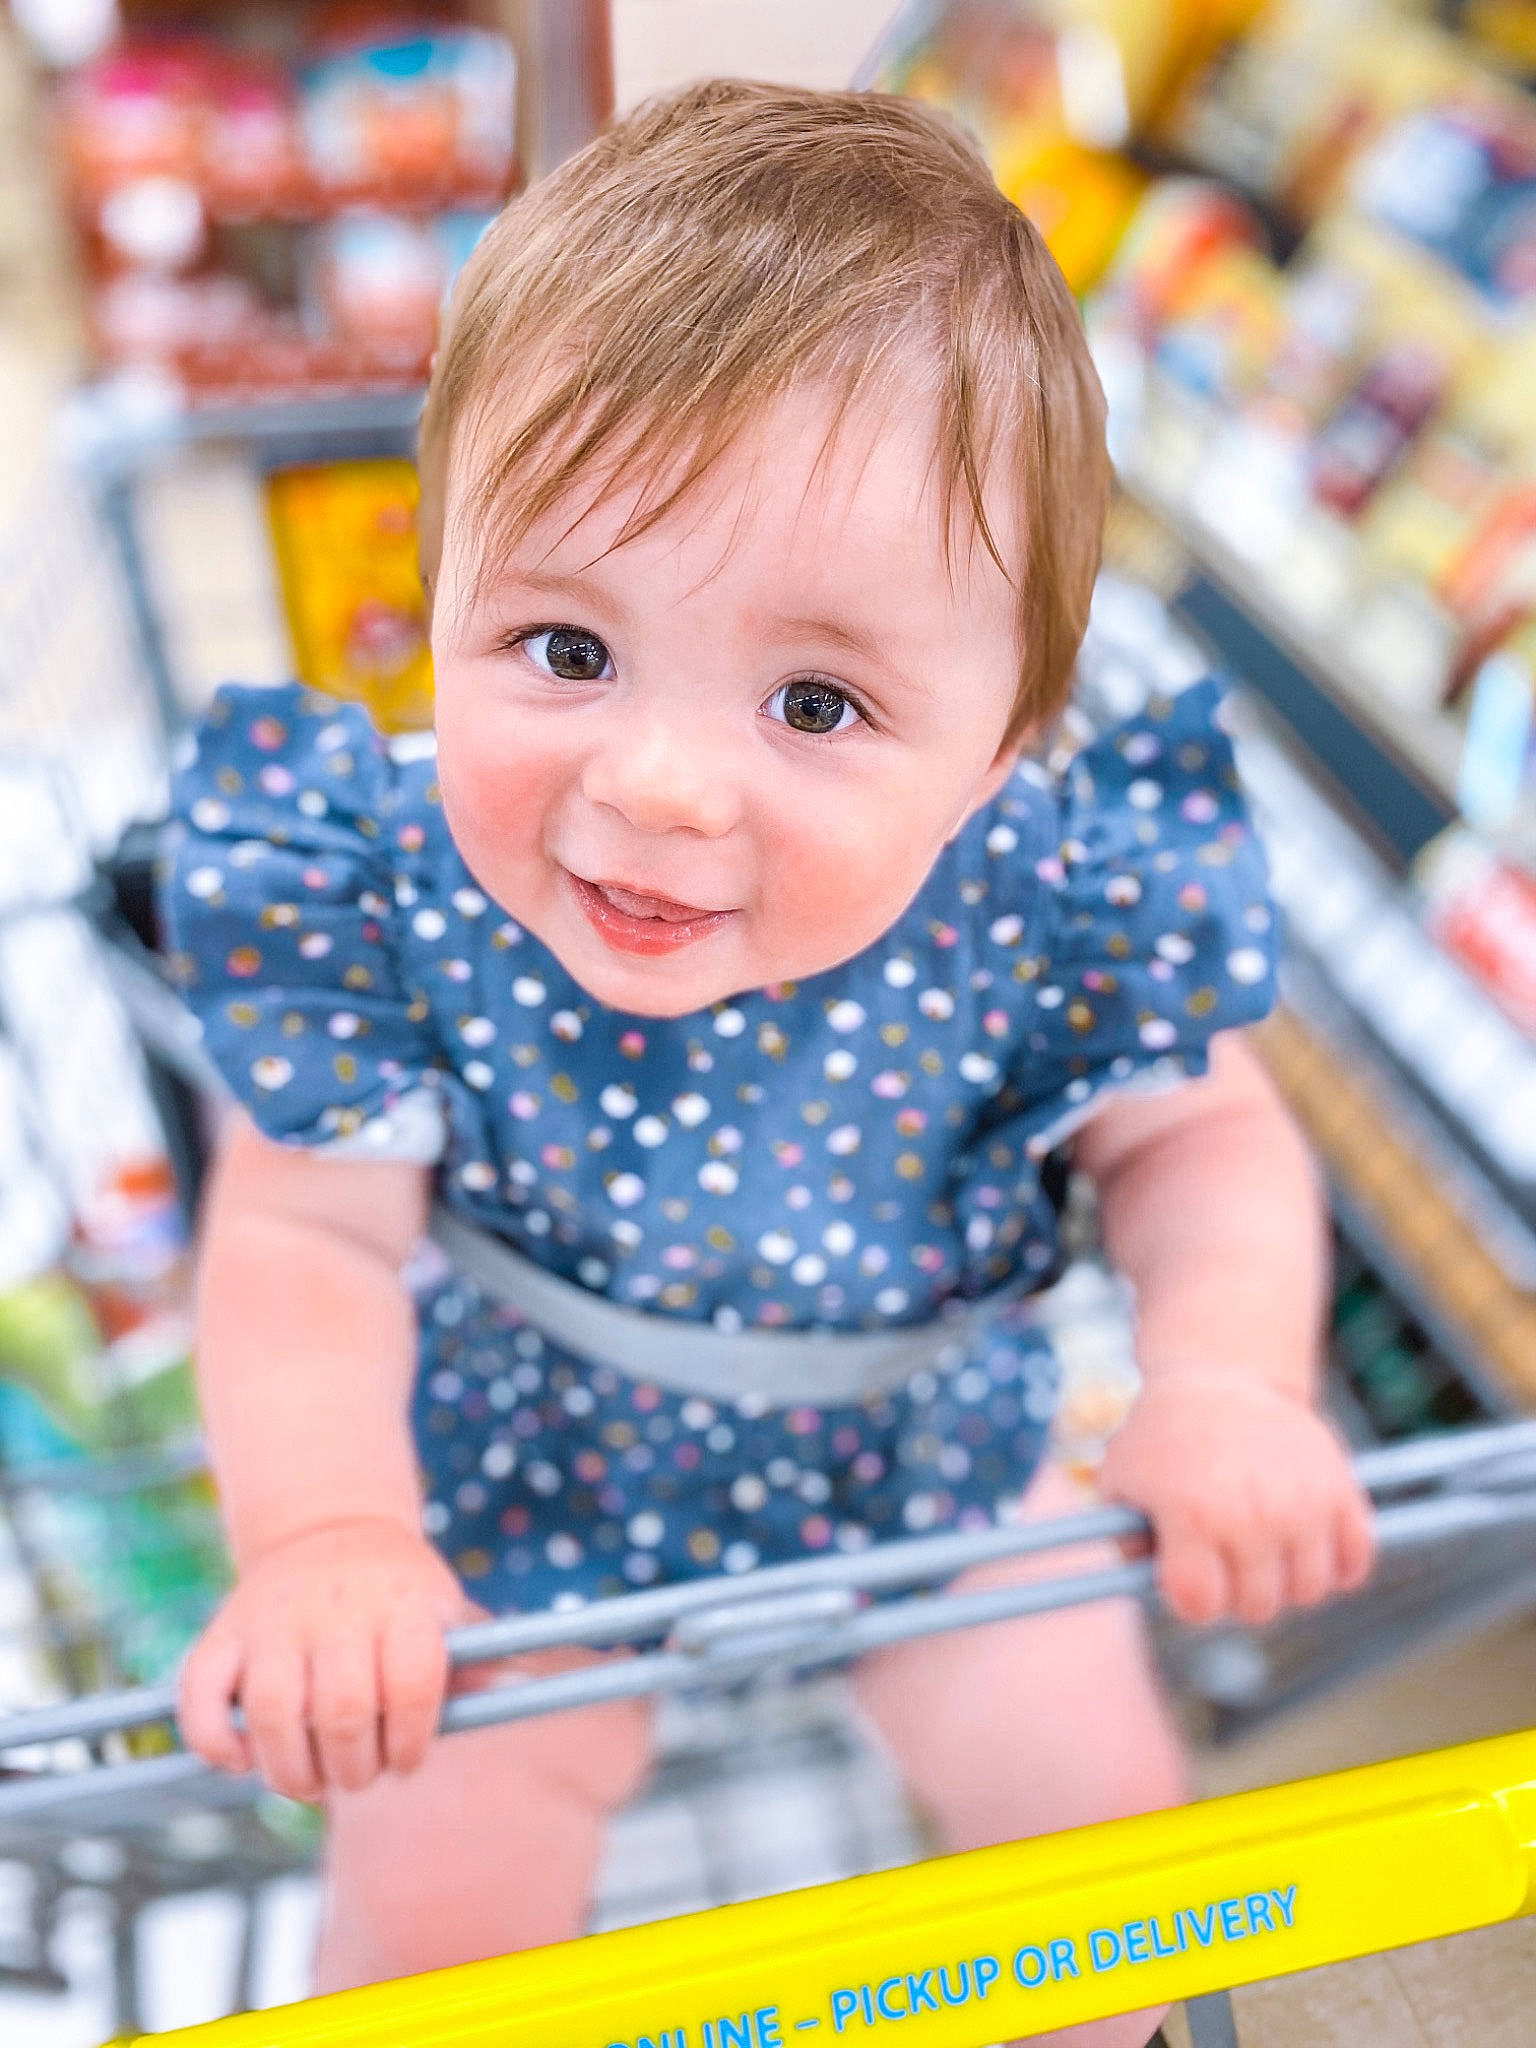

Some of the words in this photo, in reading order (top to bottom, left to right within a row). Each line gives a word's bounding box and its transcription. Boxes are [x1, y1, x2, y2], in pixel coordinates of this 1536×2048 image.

[606, 2005, 783, 2048] INE
[831, 1955, 1001, 2033] PICKUP
[1013, 1938, 1080, 1989] OR
[1088, 1885, 1298, 1972] DELIVERY
